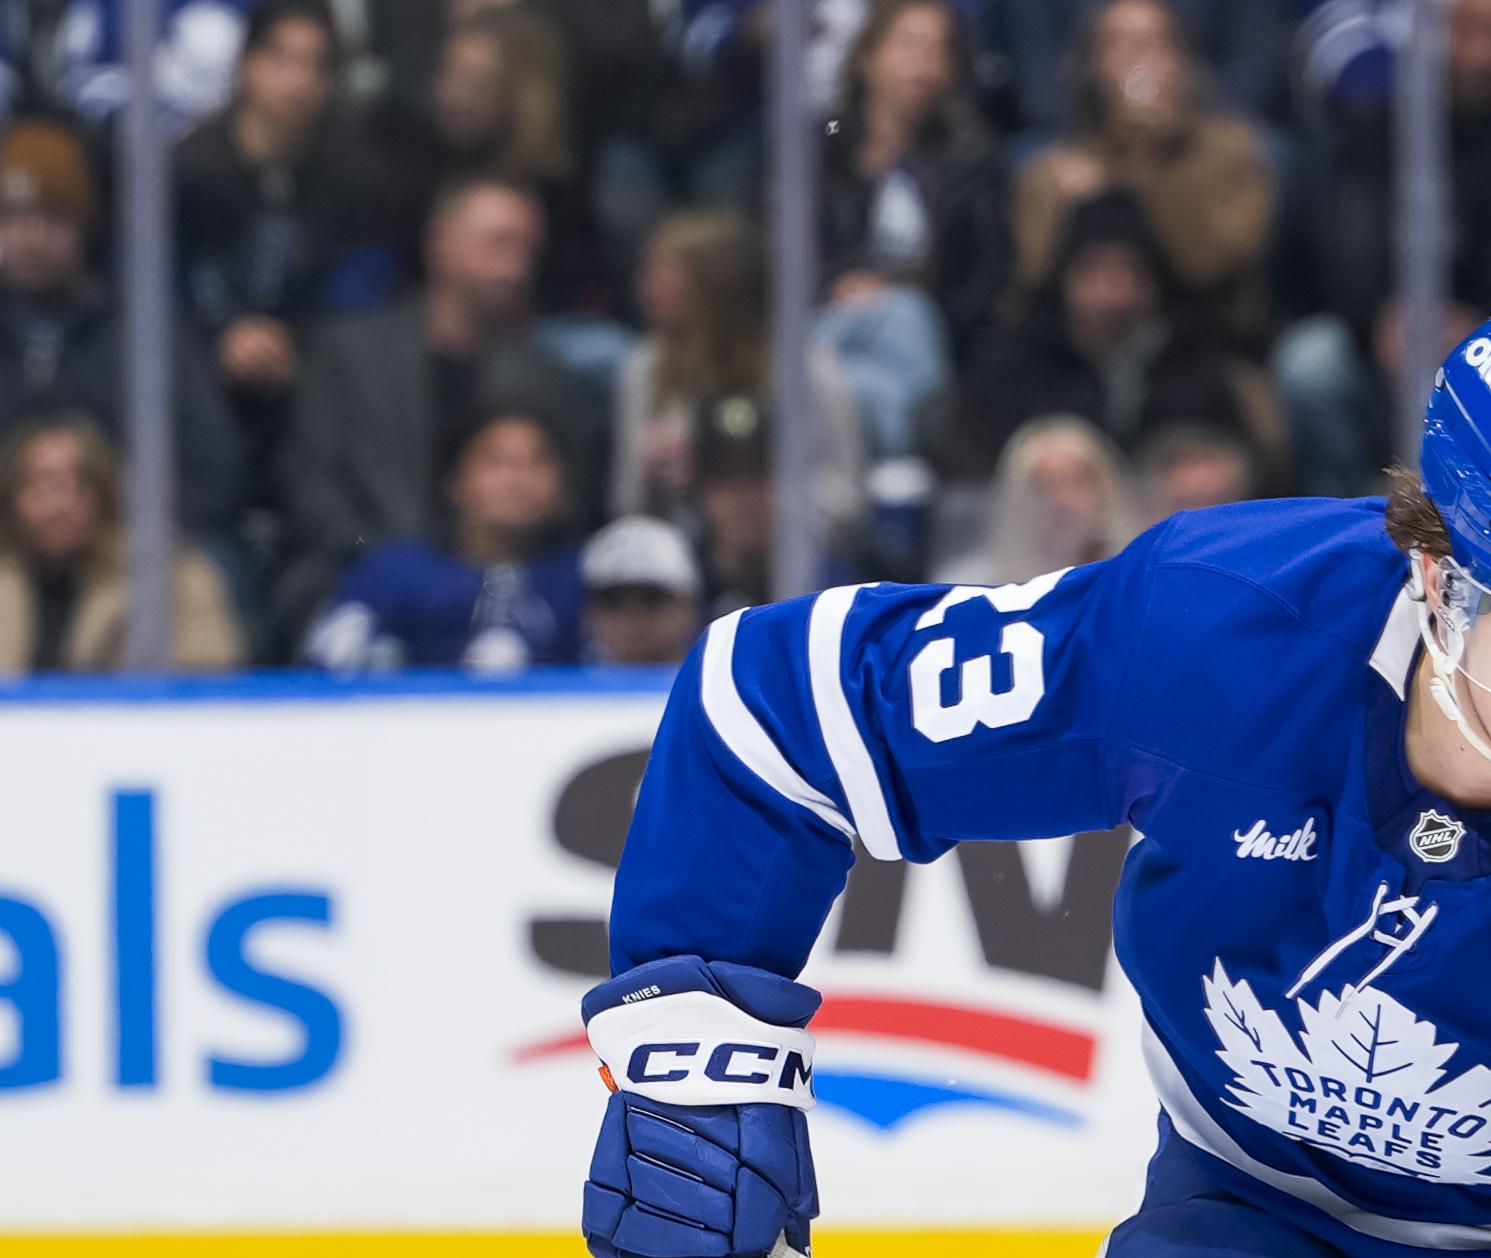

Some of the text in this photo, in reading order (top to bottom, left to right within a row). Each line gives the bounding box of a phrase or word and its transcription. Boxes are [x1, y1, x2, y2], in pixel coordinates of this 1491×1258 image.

[1418, 831, 1454, 848] NHL
[621, 984, 662, 1005] KNIES
[626, 1042, 816, 1098] CCM
[1250, 1059, 1489, 1140] TORONTO
[1287, 1088, 1446, 1153] MAPLE
[1287, 1109, 1443, 1170] LEAFS
